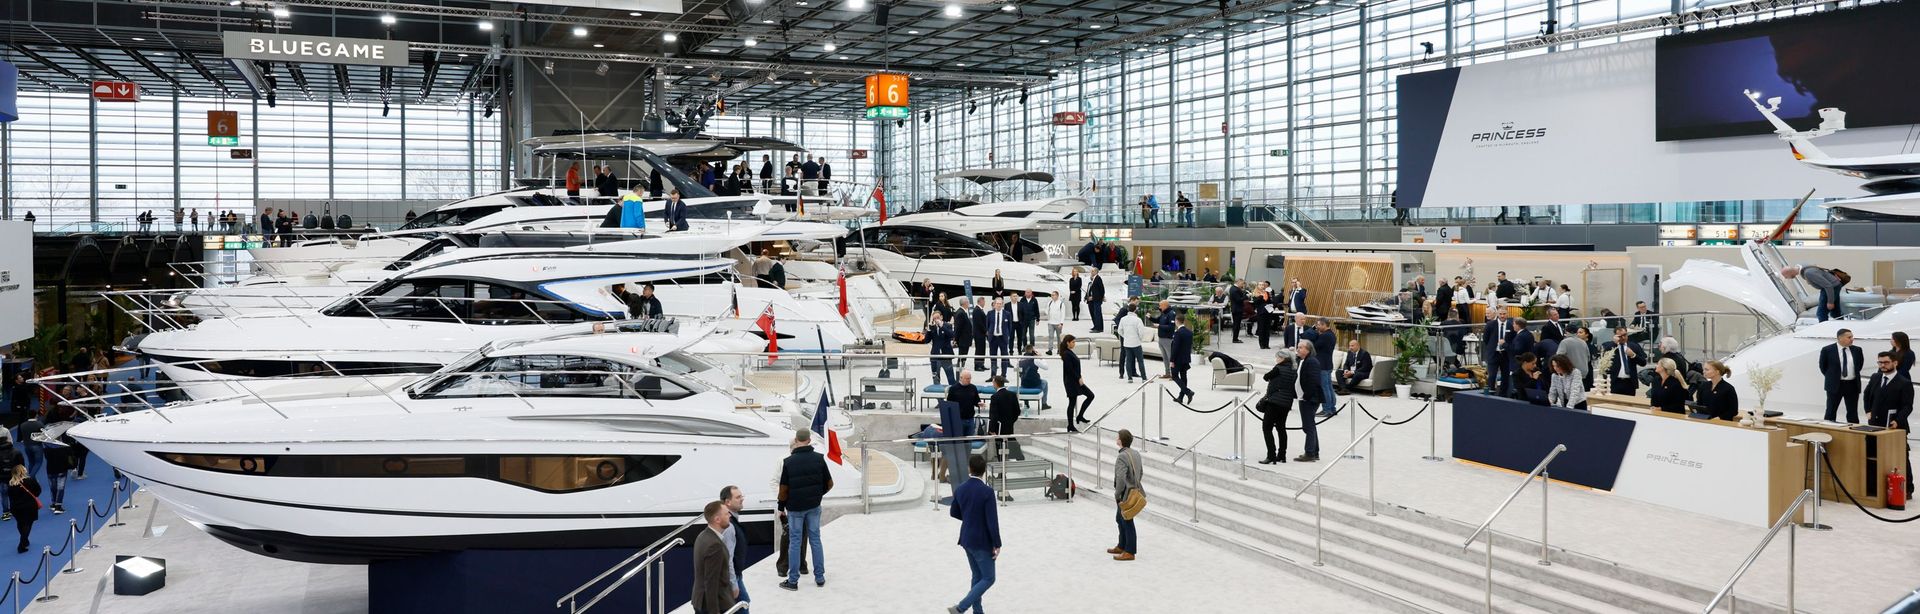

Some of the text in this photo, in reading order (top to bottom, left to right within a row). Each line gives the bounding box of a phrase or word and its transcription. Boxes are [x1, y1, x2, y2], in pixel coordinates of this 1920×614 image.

[249, 38, 385, 60] BLUEGAME
[869, 84, 875, 104] 6
[887, 84, 899, 104] 6
[217, 119, 228, 134] 6
[1471, 128, 1546, 142] PRINCESS
[1423, 227, 1447, 238] Gallery G
[1646, 454, 1704, 469] PRINCESS
